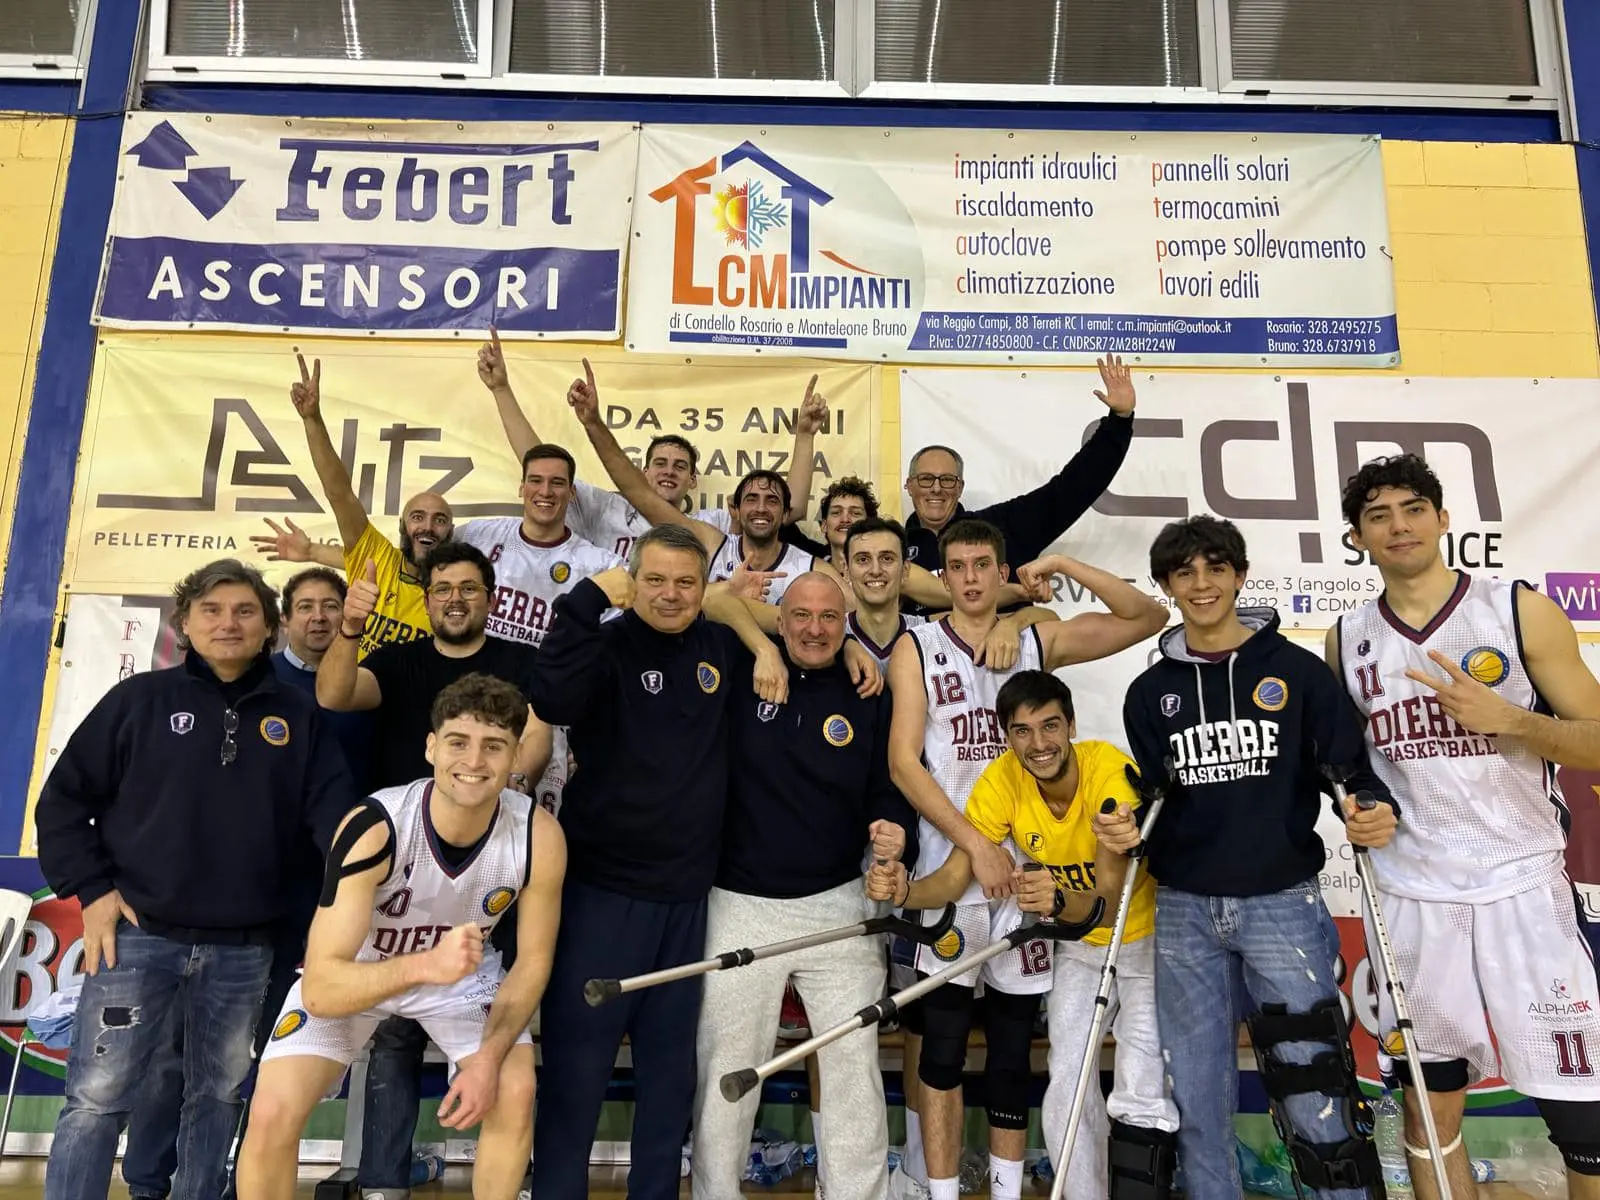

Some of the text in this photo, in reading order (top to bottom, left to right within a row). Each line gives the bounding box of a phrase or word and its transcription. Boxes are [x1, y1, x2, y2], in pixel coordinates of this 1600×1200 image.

[955, 152, 1118, 185] impianti idraulici
[1152, 154, 1289, 187] pannelli solari
[276, 138, 598, 227] Febert
[955, 191, 1094, 218] riscaldamento
[1153, 195, 1280, 220] termocamini
[956, 228, 1052, 257] autoclave
[1156, 228, 1366, 262] pompe sollevamento
[148, 255, 560, 312] ASCENSORI
[956, 268, 1116, 295] climatizzazione
[1159, 267, 1260, 298] lavori edili
[669, 312, 907, 337] di Condello Rosario e Monteleone Bruno
[925, 317, 940, 329] via
[943, 315, 975, 333] Reggio
[978, 316, 1012, 332] Campi,
[1015, 316, 1029, 329] 88
[1032, 316, 1061, 330] Terreti
[1064, 317, 1077, 330] RC
[1116, 318, 1232, 335] c.m.impianti@outlook.it
[1266, 320, 1381, 334] Rosario: 328.2495275
[956, 334, 1033, 349] 02774850800
[1043, 335, 1059, 349] C.F.
[1063, 336, 1176, 351] CNDRSR72M28H224W
[1268, 338, 1376, 353] Bruno: 328.6737918
[606, 405, 662, 430] DA
[680, 407, 724, 432] 35
[94, 531, 238, 551] PELLETTERIA
[1282, 577, 1292, 590] 3
[1298, 576, 1361, 594] (angolo
[1365, 578, 1380, 592] S.
[1316, 597, 1357, 612] CDM
[931, 671, 967, 707] 12
[1353, 661, 1385, 701] 11
[1169, 719, 1280, 769] DIERRE
[1384, 738, 1498, 764] BASKETBALL
[1178, 758, 1270, 786] BASKETBALL
[1018, 938, 1051, 977] 12
[1527, 1000, 1592, 1015] ALPHATEK
[1551, 1031, 1594, 1077] 11
